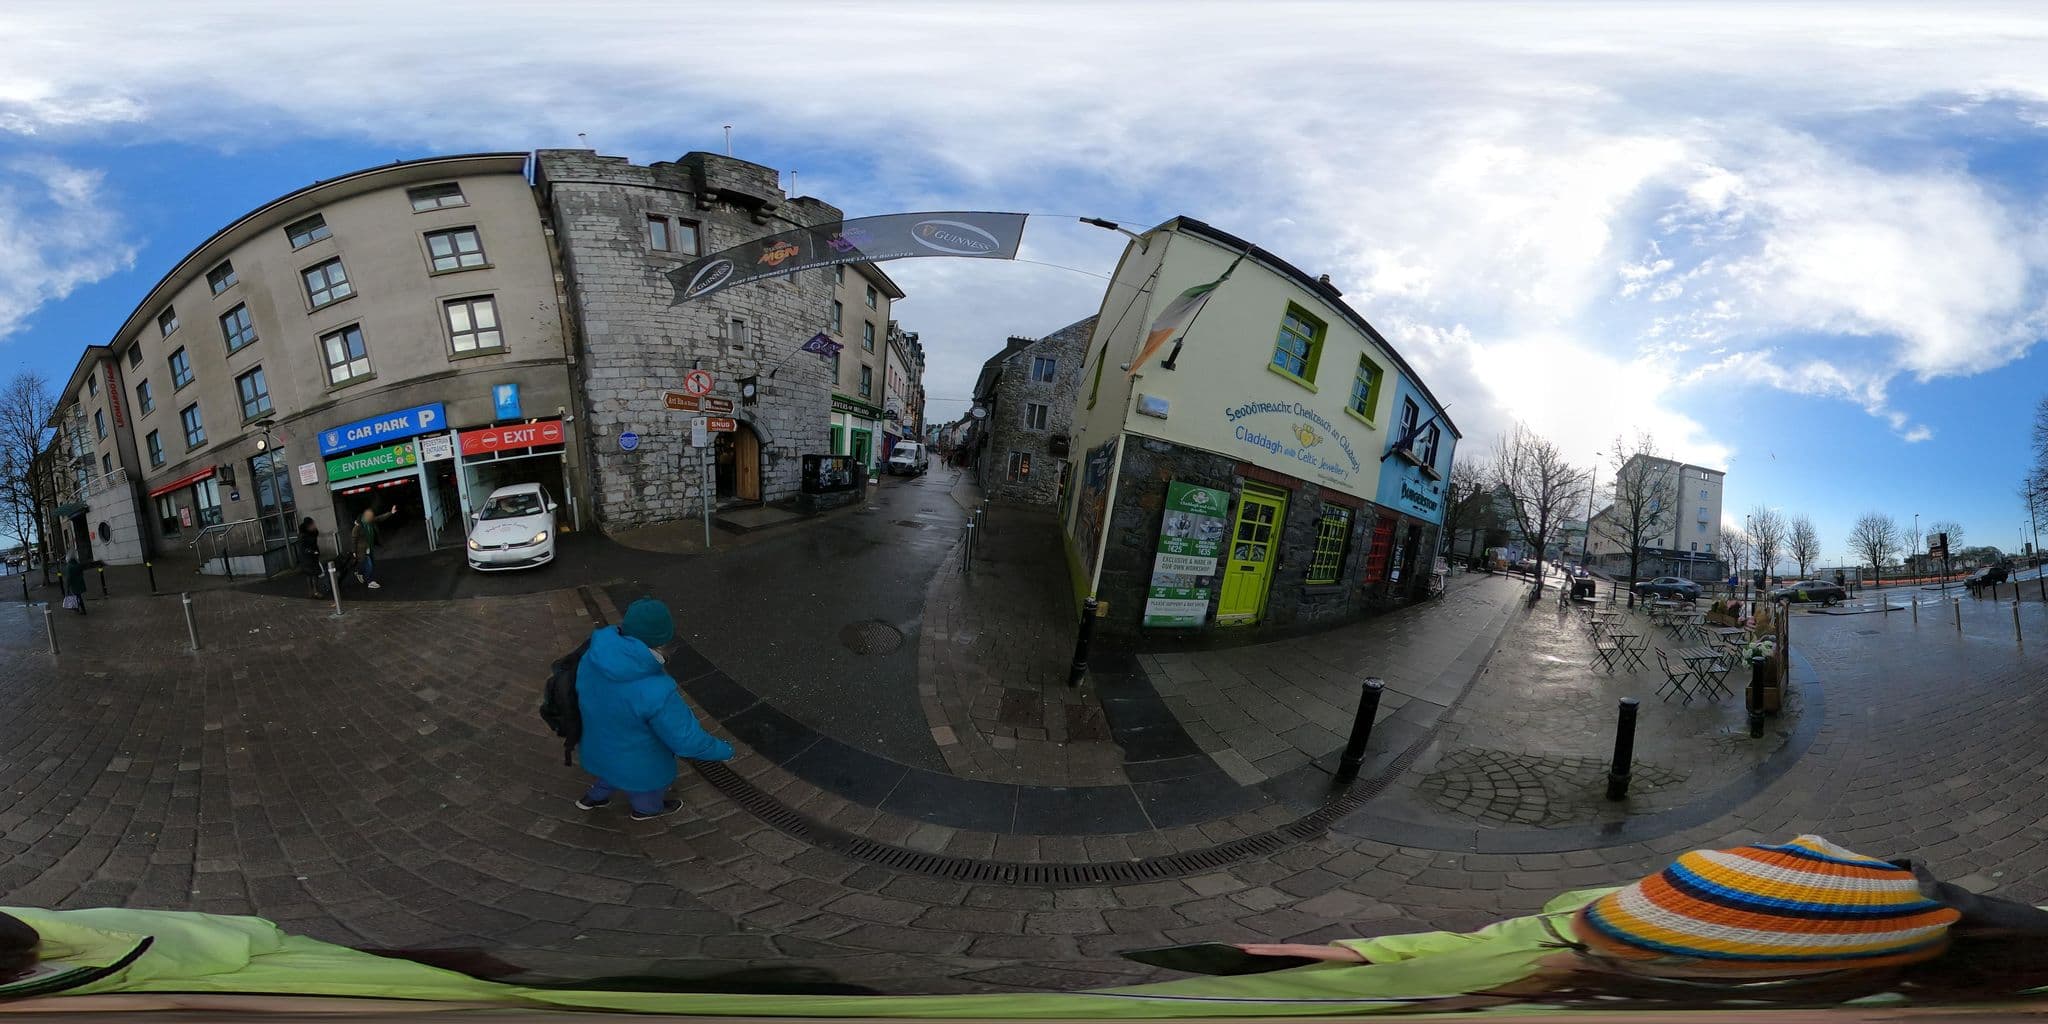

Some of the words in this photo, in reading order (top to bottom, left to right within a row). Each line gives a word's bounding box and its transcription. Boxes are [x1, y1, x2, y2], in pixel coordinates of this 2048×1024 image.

[934, 230, 992, 251] GUINNESS
[800, 261, 829, 270] NATIONS
[696, 263, 729, 290] GUINNESS
[347, 426, 372, 441] CAR
[374, 416, 409, 434] PARK
[418, 409, 435, 428] P
[503, 429, 536, 444] EXIT
[1235, 425, 1283, 454] Claddagh
[1297, 448, 1318, 466] Celtic
[342, 453, 394, 473] ENTRANCE
